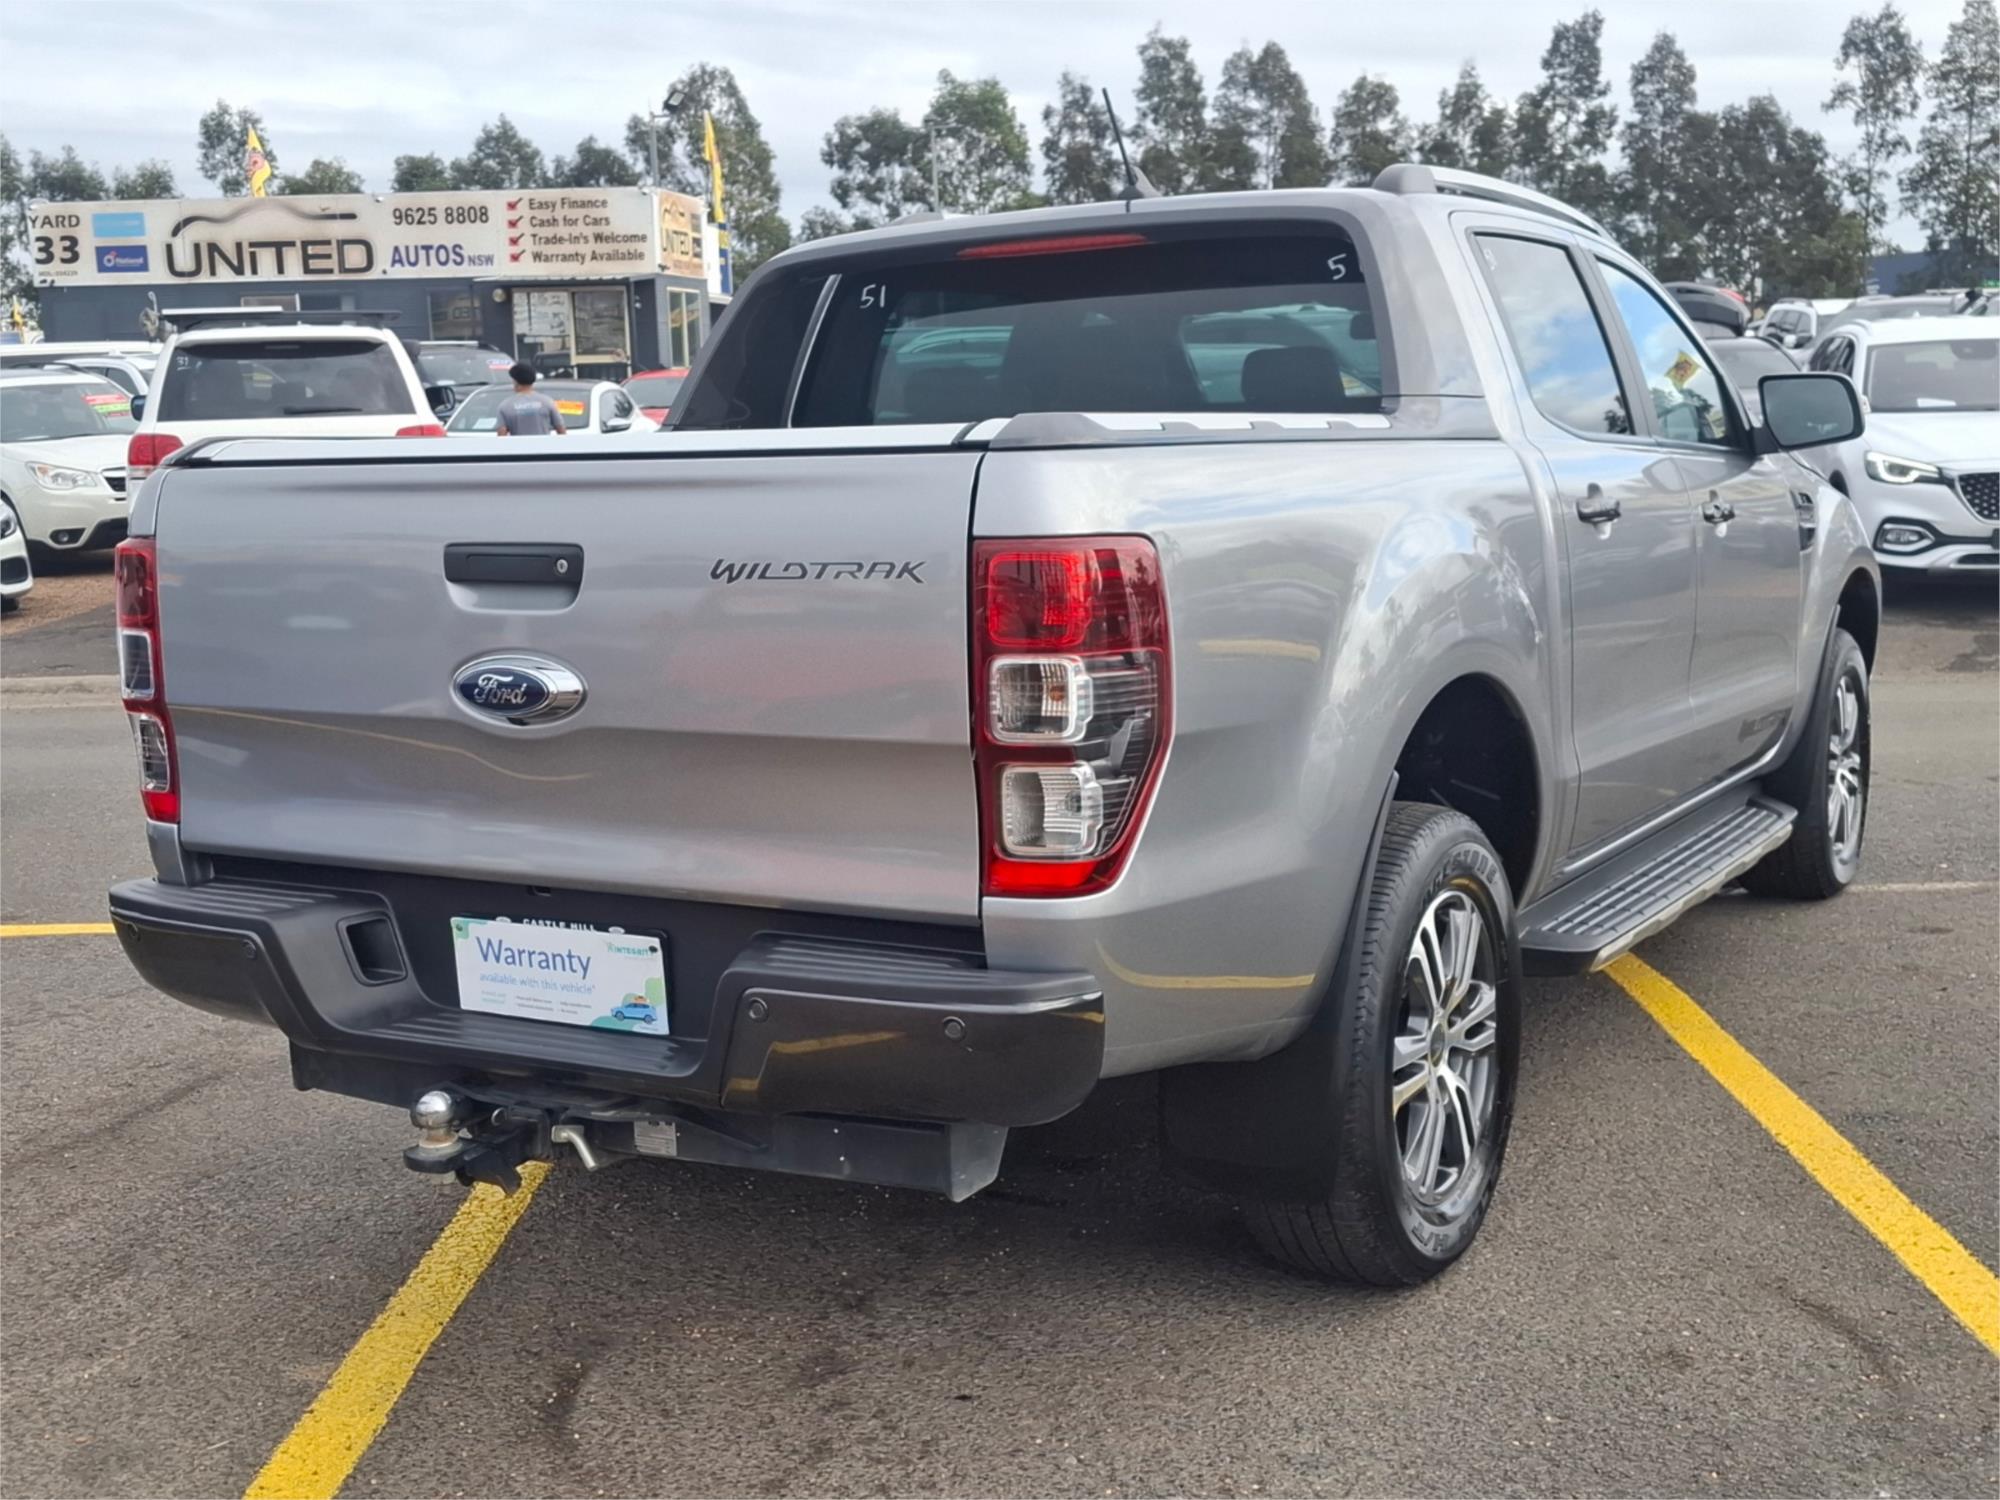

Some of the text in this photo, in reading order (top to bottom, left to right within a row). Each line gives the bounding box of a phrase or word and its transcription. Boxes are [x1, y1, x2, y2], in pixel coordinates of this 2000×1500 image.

[392, 205, 490, 226] 9625 8808
[528, 197, 608, 212] Easy Finance
[28, 214, 81, 229] YARD
[529, 214, 610, 228] Cash for Cars
[34, 235, 81, 265] 33
[530, 231, 648, 246] Trade-In's Welcome
[165, 238, 374, 278] UNITED
[390, 243, 494, 268] AUTOS NSW
[531, 249, 646, 265] Warranty Available
[1327, 253, 1347, 281] 5
[860, 283, 887, 309] 51
[709, 558, 926, 585] WILDTRAK
[473, 673, 528, 704] Ford
[475, 935, 592, 980] Warranty
[479, 972, 518, 987] available
[519, 974, 540, 989] with
[541, 977, 559, 991] this
